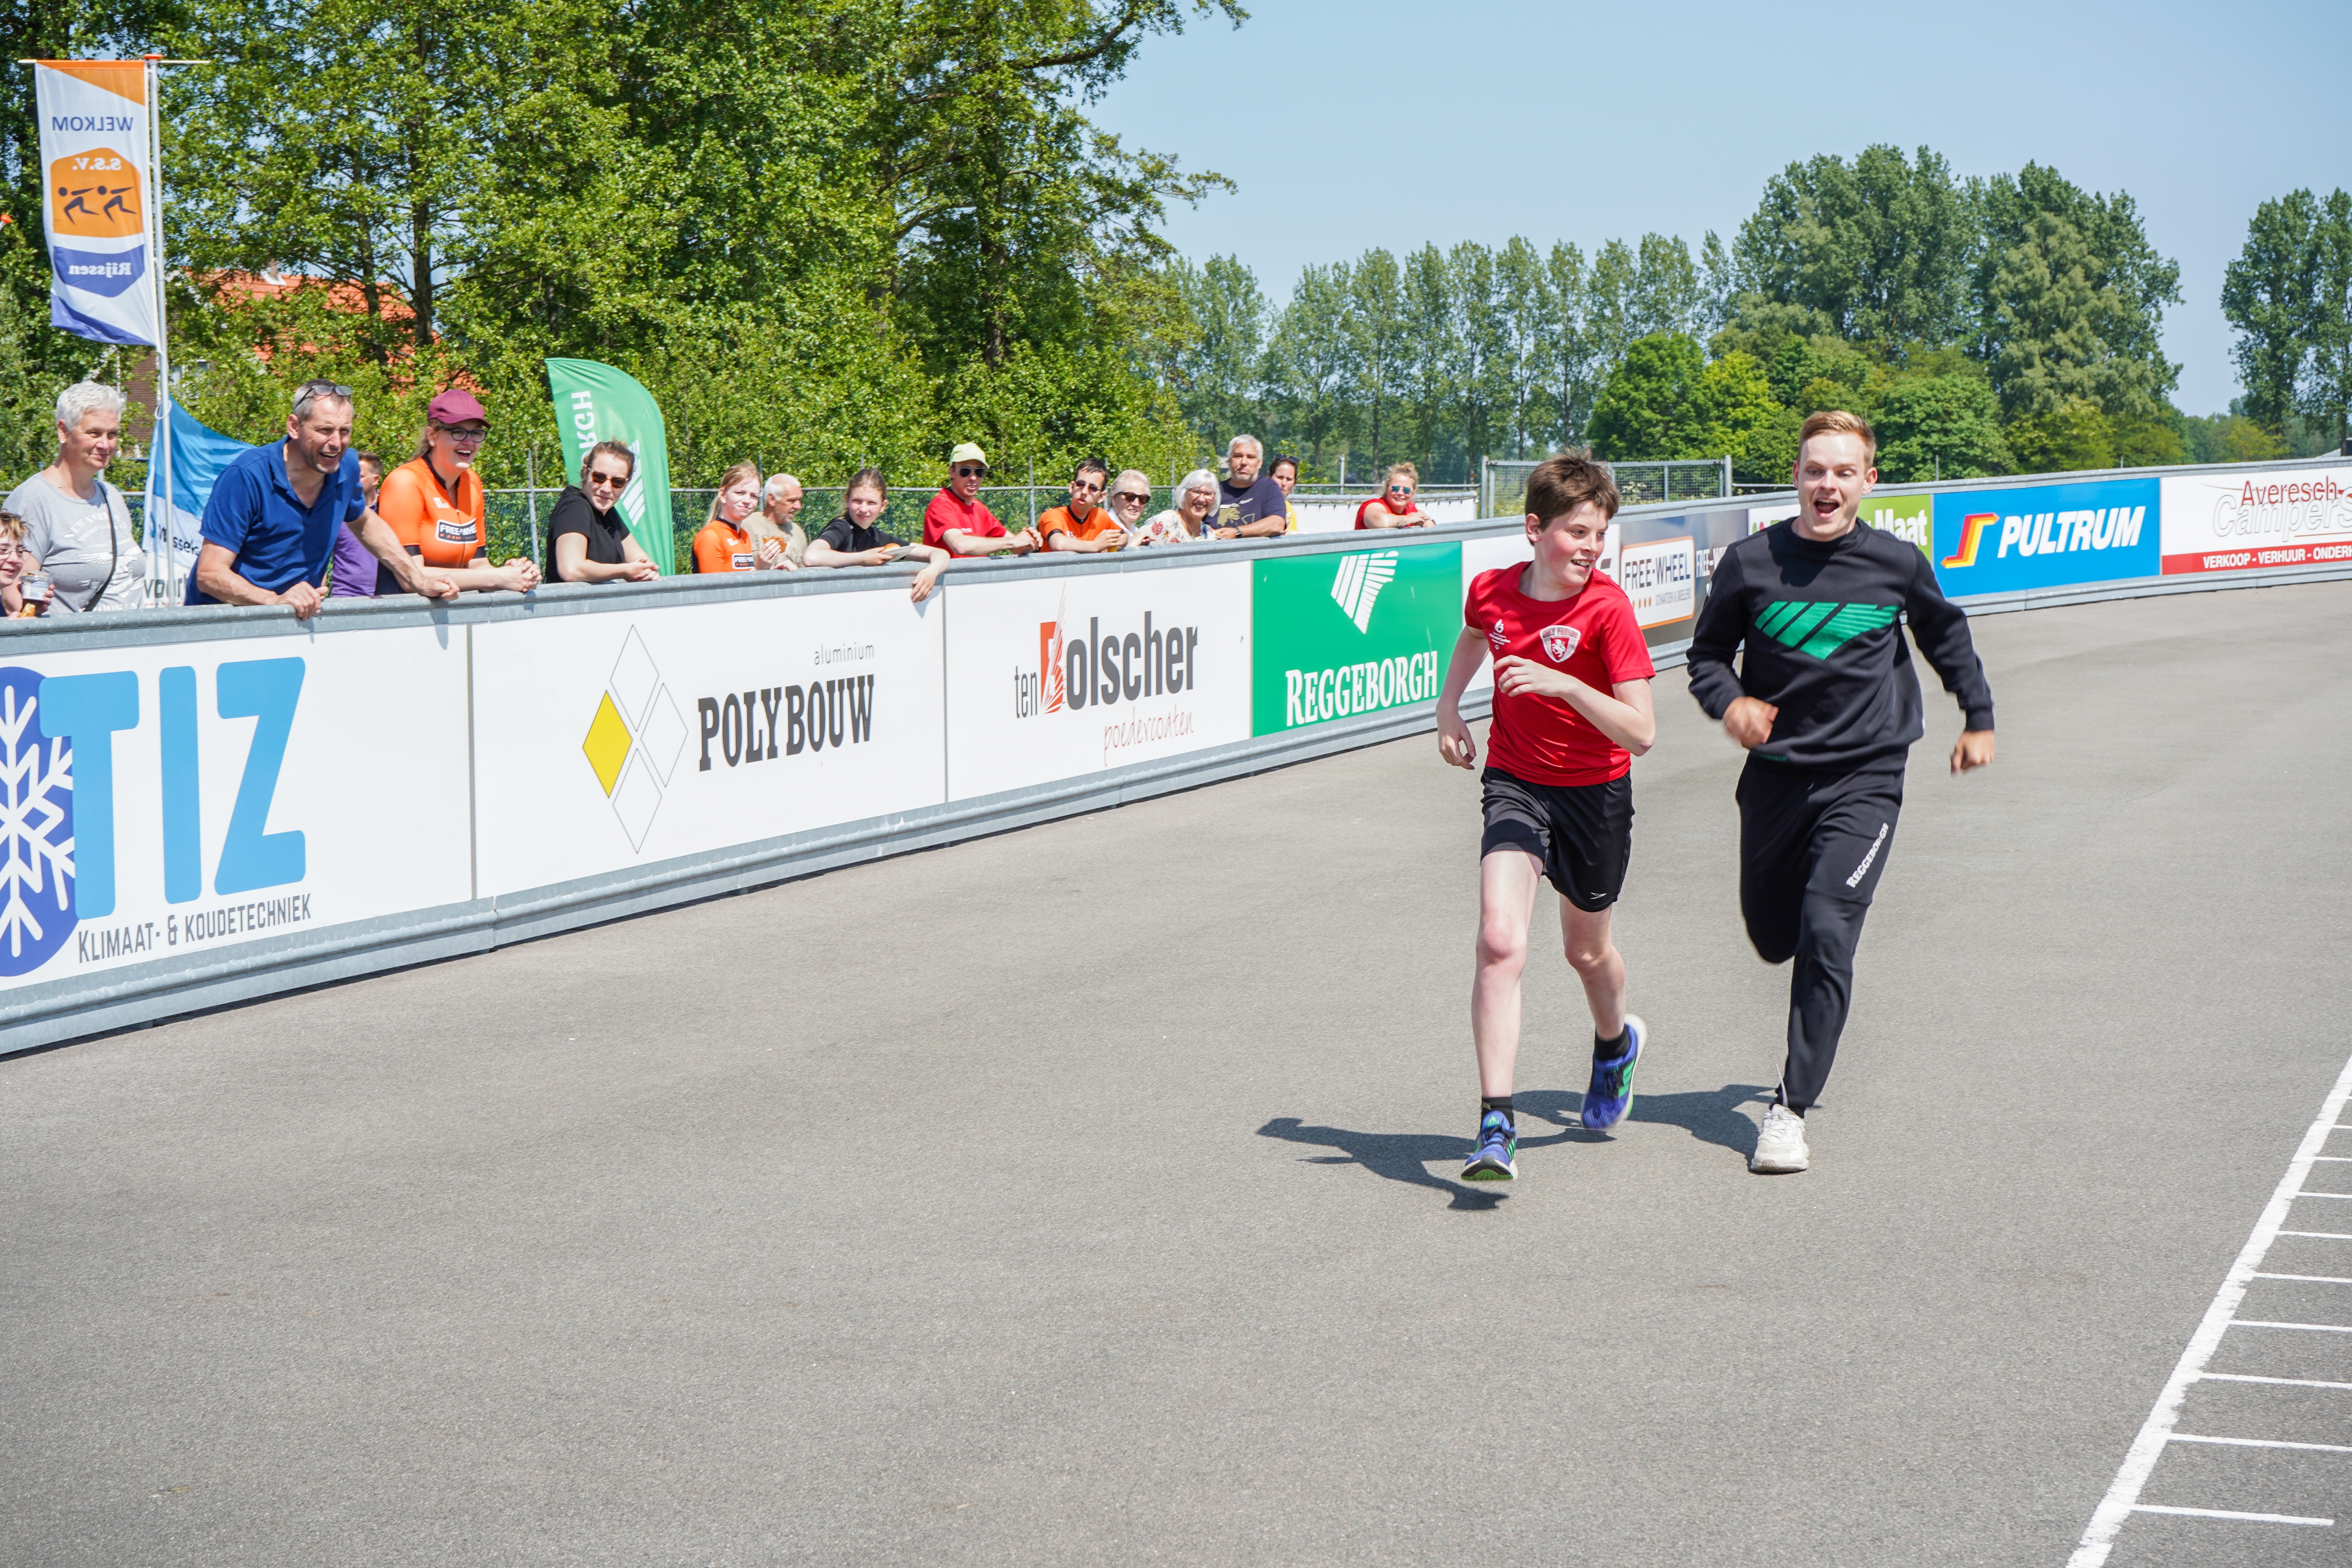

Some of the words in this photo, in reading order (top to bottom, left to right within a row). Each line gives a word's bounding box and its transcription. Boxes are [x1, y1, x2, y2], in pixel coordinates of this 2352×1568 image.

[2241, 476, 2337, 506] Averesch
[1875, 508, 1927, 546] Maat
[1997, 505, 2146, 558] PULTRUM
[1625, 552, 1691, 591] FREE-WHEEL
[2203, 552, 2251, 569] VERKOOP
[2258, 548, 2306, 564] VERHUUR
[815, 642, 875, 665] aluminium
[1014, 665, 1038, 719] ten
[1285, 650, 1438, 727] REGGEBORGH
[698, 674, 875, 772] POLYBOUW
[1103, 704, 1194, 767] poedercoaten
[38, 656, 306, 920] TIZ
[168, 914, 178, 946] &
[185, 893, 311, 943] KOUDETECHNIEK
